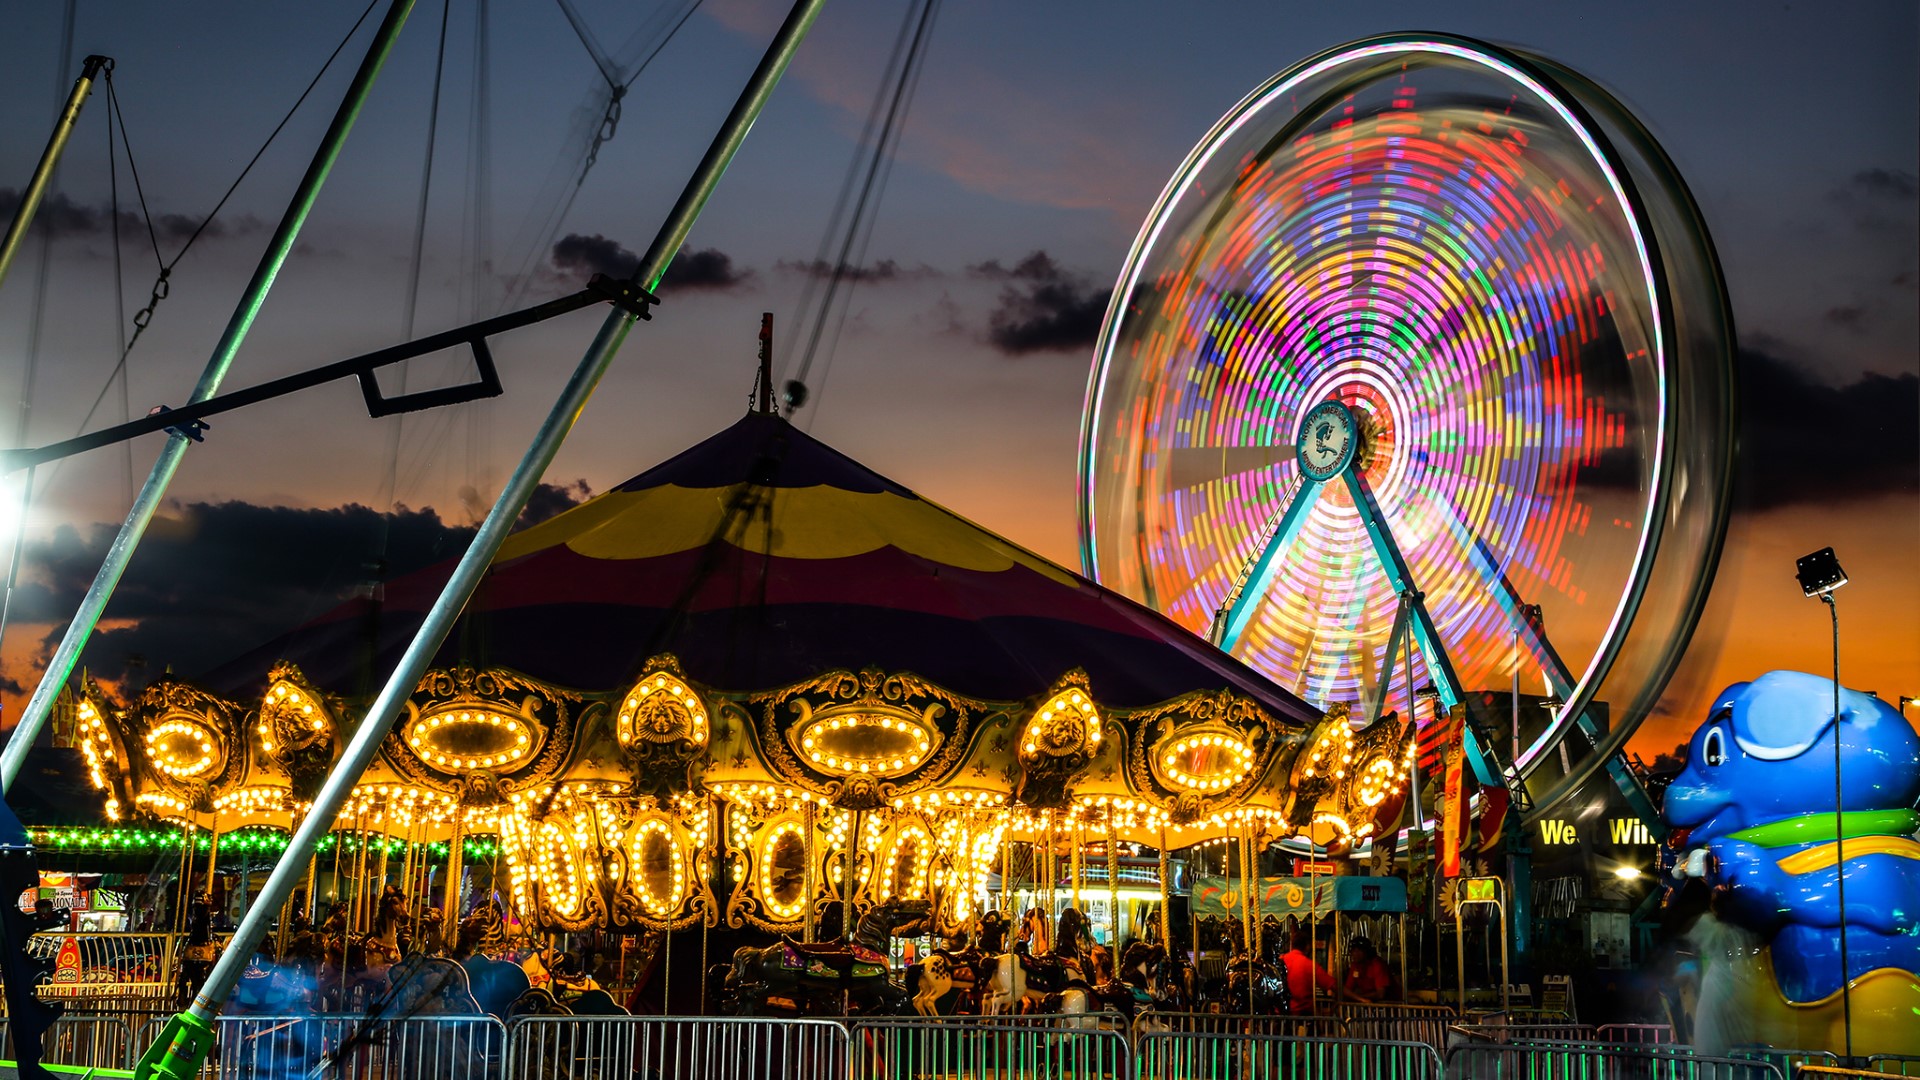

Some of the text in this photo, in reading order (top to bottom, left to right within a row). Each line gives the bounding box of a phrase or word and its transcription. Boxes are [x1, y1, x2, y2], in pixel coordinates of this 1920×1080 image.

[1302, 413, 1318, 441] NORTH
[1061, 862, 1098, 881] FSH
[1104, 864, 1128, 882] CT
[52, 897, 88, 908] MONADE
